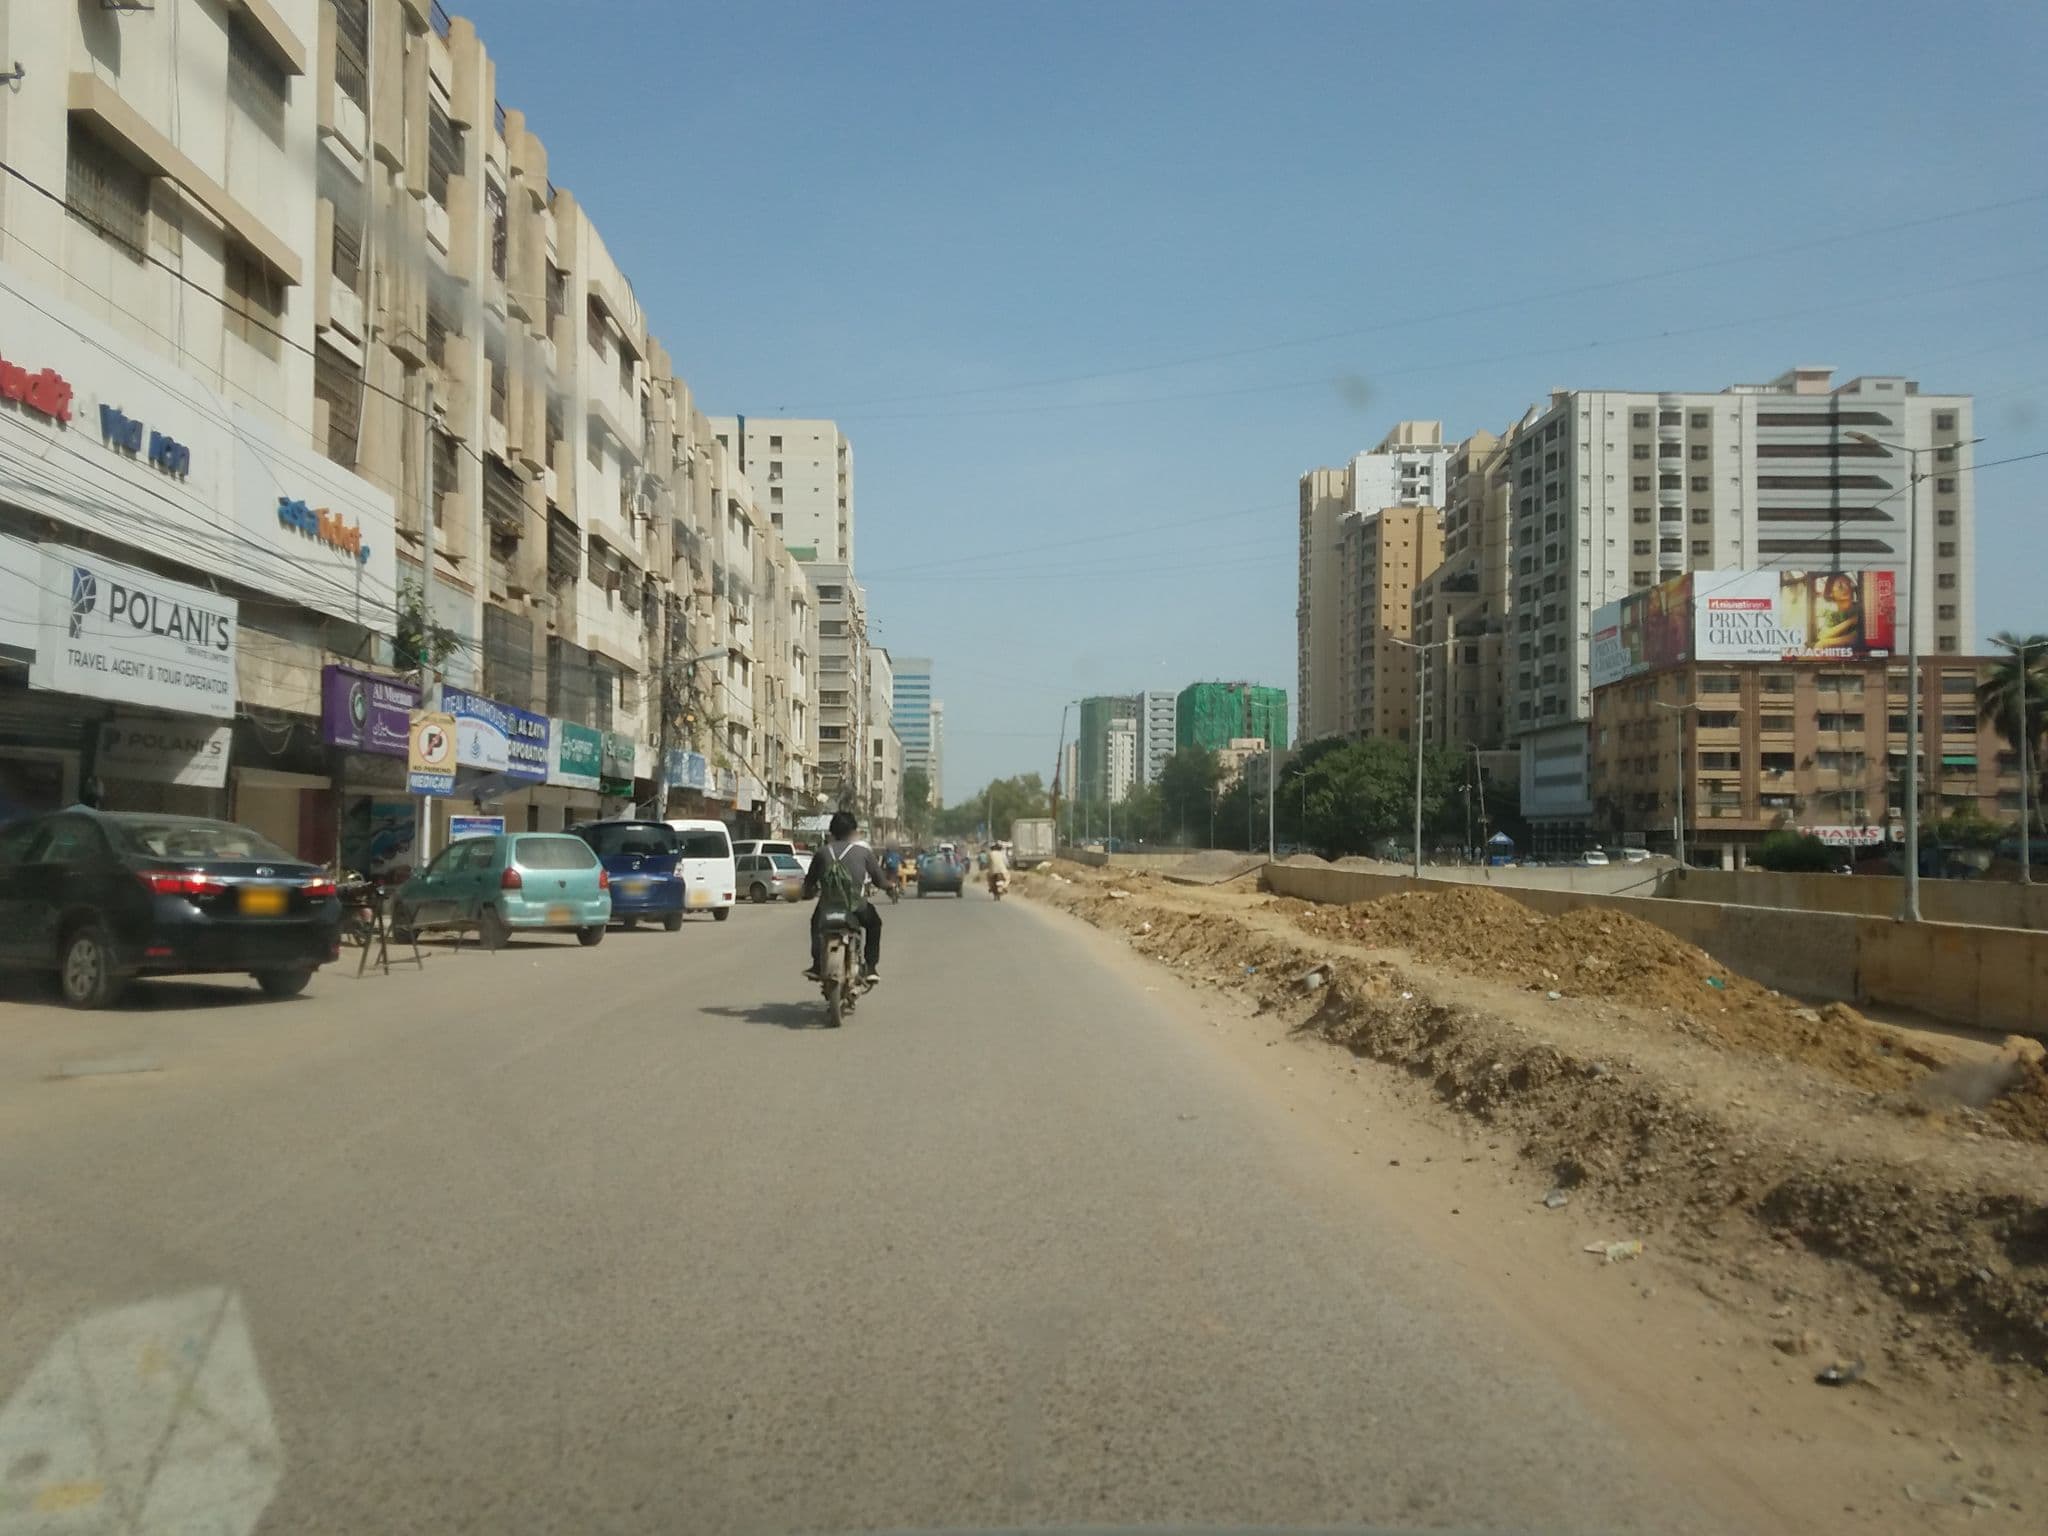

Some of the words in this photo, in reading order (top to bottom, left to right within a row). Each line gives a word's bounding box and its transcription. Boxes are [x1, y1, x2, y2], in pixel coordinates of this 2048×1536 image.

[110, 583, 229, 651] POLANI'S
[1709, 612, 1773, 628] PRINTS
[1709, 628, 1801, 645] CHARMING
[68, 649, 108, 672] TRAVEL
[111, 660, 145, 678] AGENT
[148, 667, 153, 680] &
[157, 667, 181, 687] TOUR
[184, 673, 229, 695] OPERATOR
